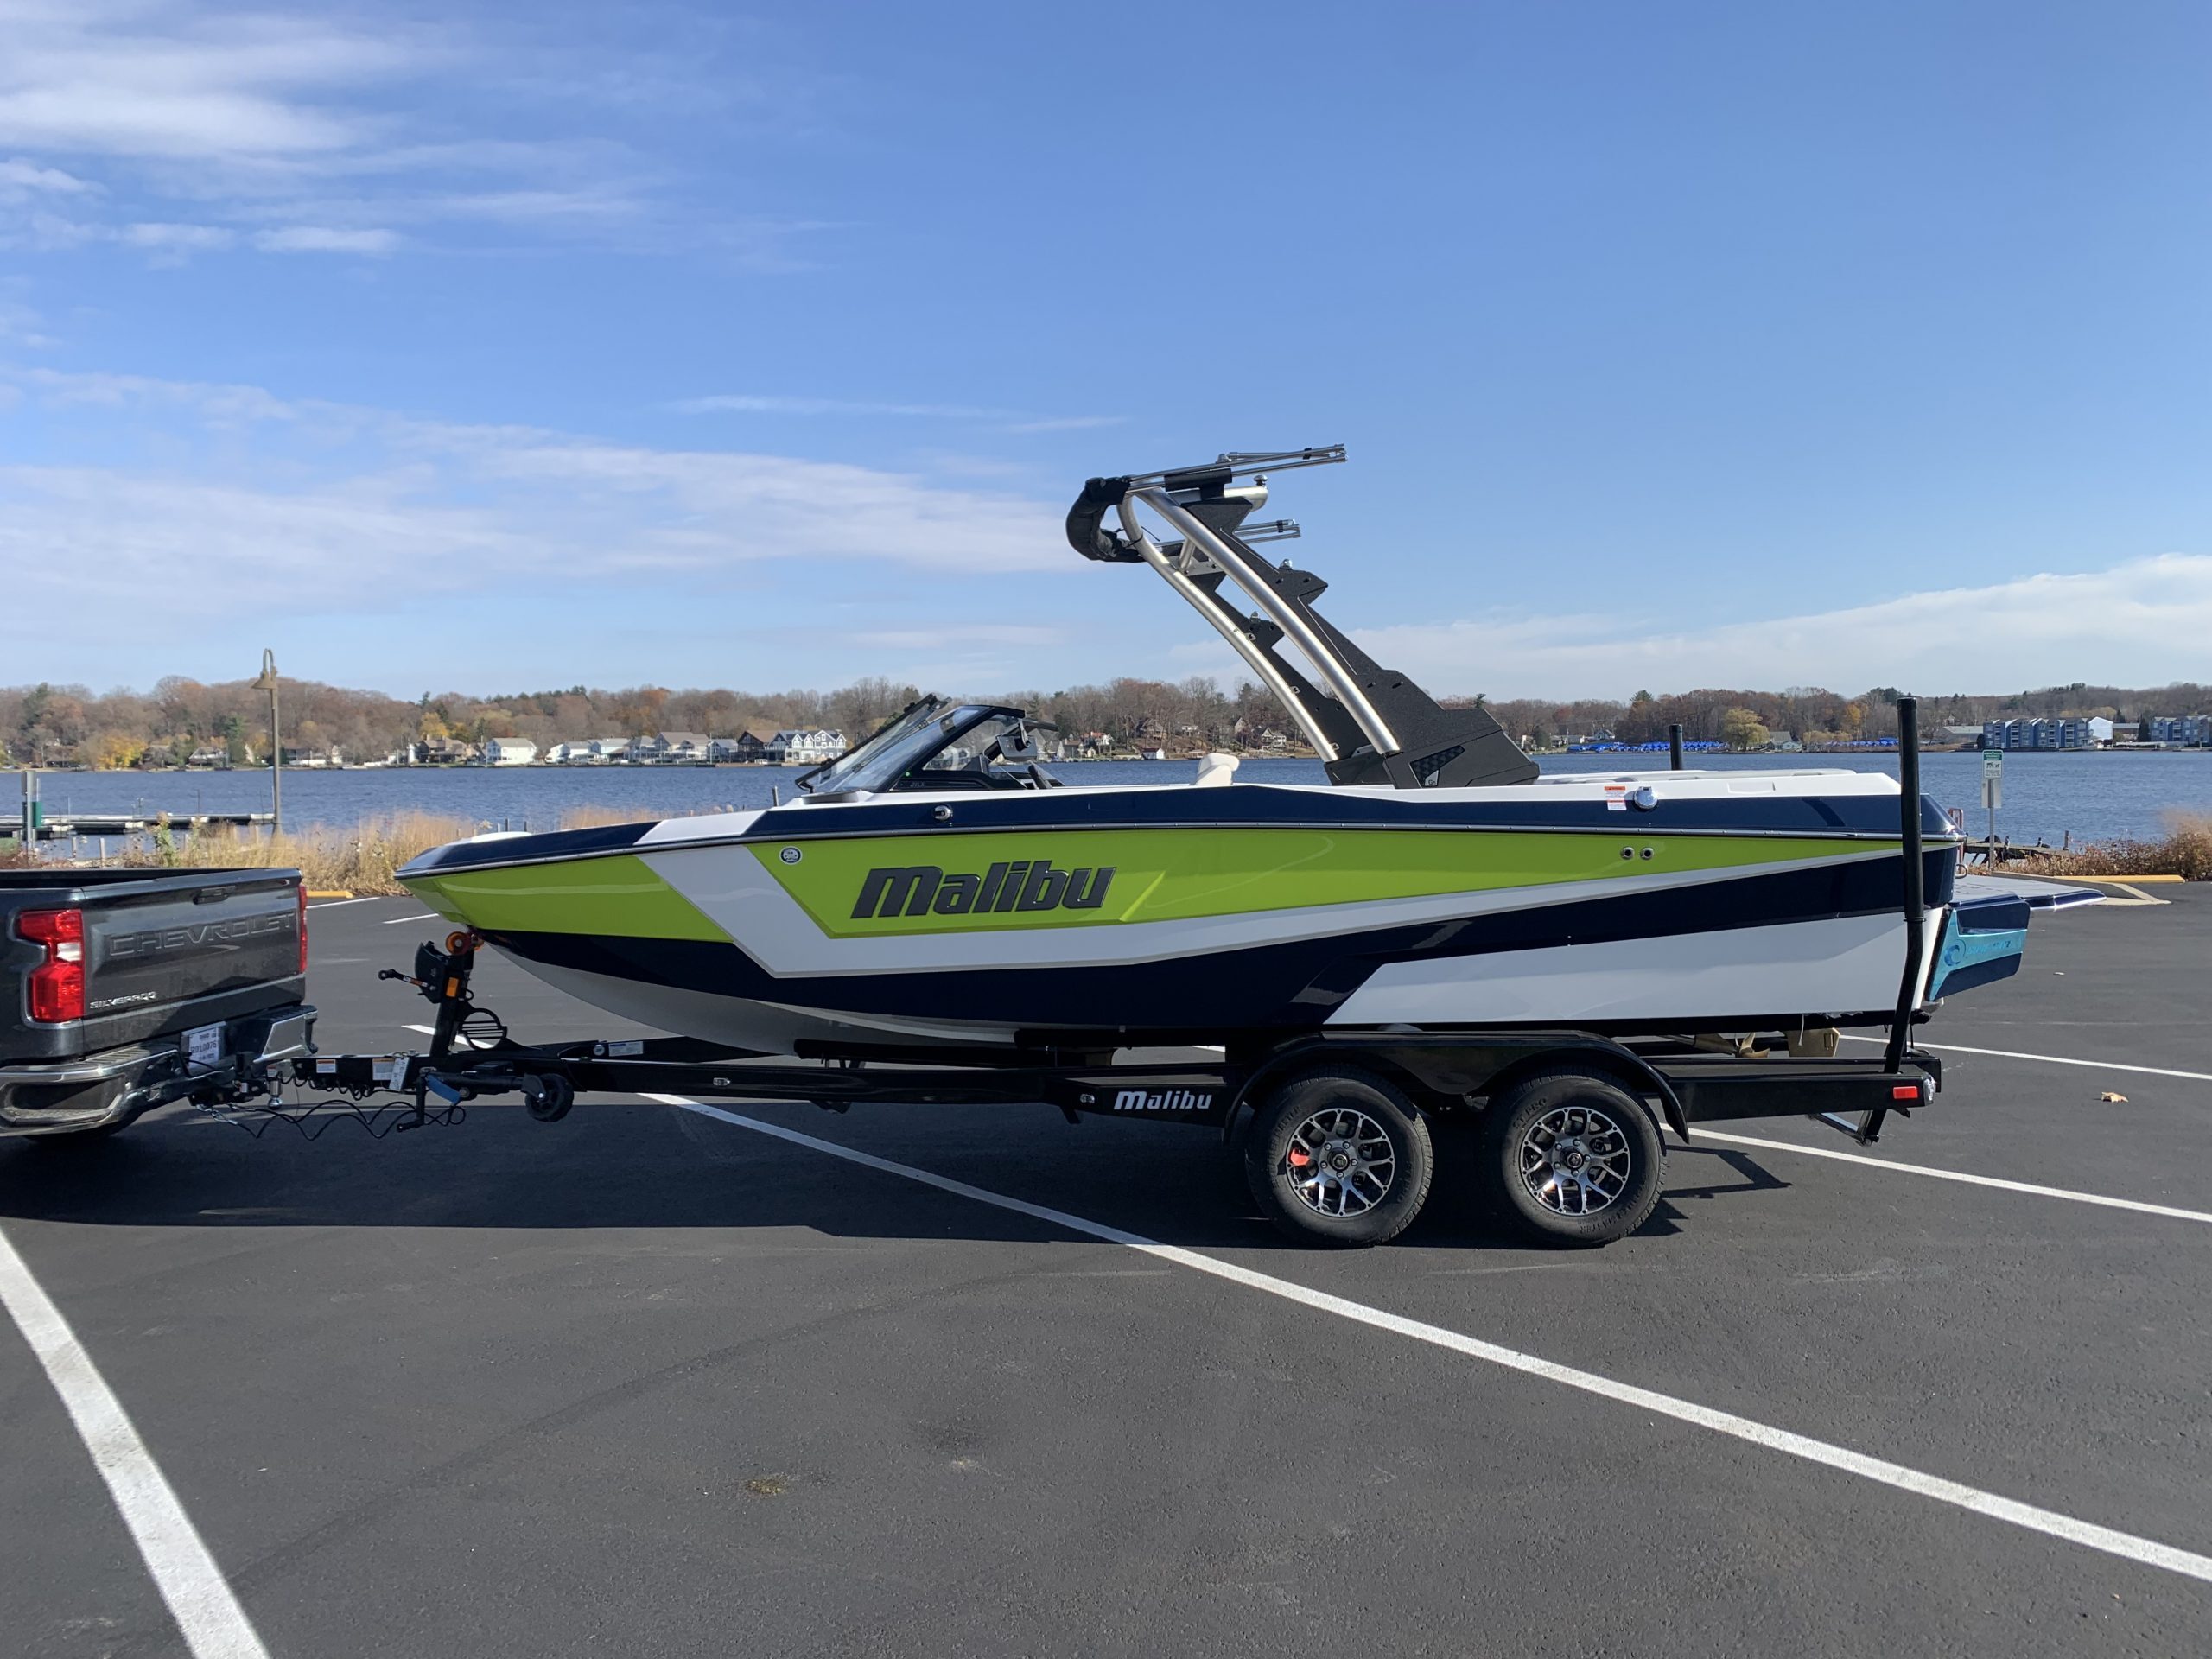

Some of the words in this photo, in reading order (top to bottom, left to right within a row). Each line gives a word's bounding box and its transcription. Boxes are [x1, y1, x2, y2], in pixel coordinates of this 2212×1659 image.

[849, 860, 1117, 919] Malibu
[110, 912, 296, 957] CHEVROLET
[89, 991, 156, 1009] SILVERADO
[1113, 1090, 1212, 1110] Malibu
